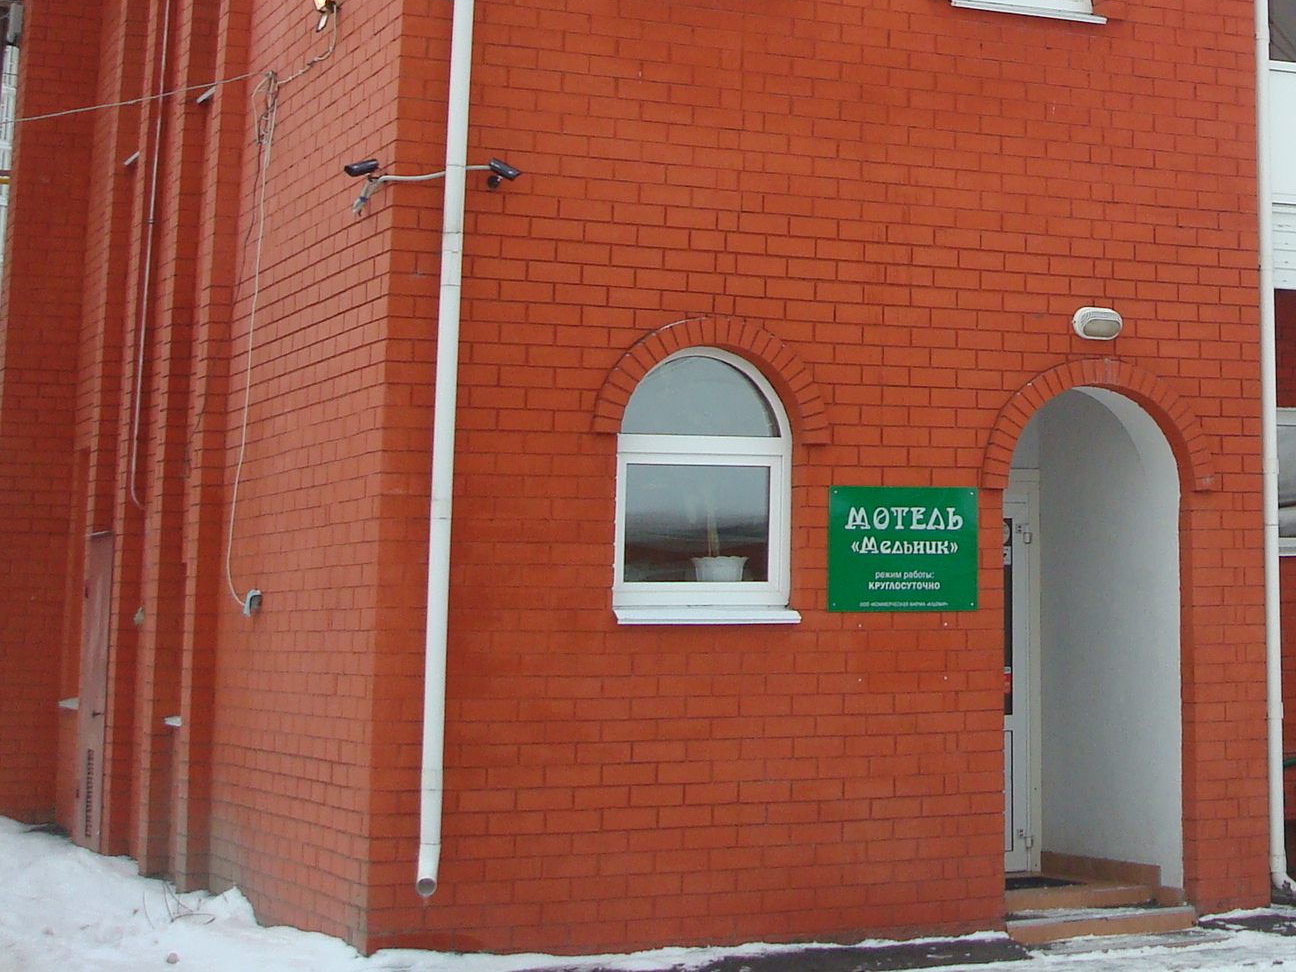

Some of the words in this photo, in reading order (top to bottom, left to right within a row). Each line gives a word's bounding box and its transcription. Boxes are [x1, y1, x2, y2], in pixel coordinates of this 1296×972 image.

[845, 507, 963, 530] МОТЕЛЬ
[875, 571, 902, 579] режим
[903, 570, 935, 580] работы:
[868, 581, 941, 590] КРУГЛОСУТОЧНО
